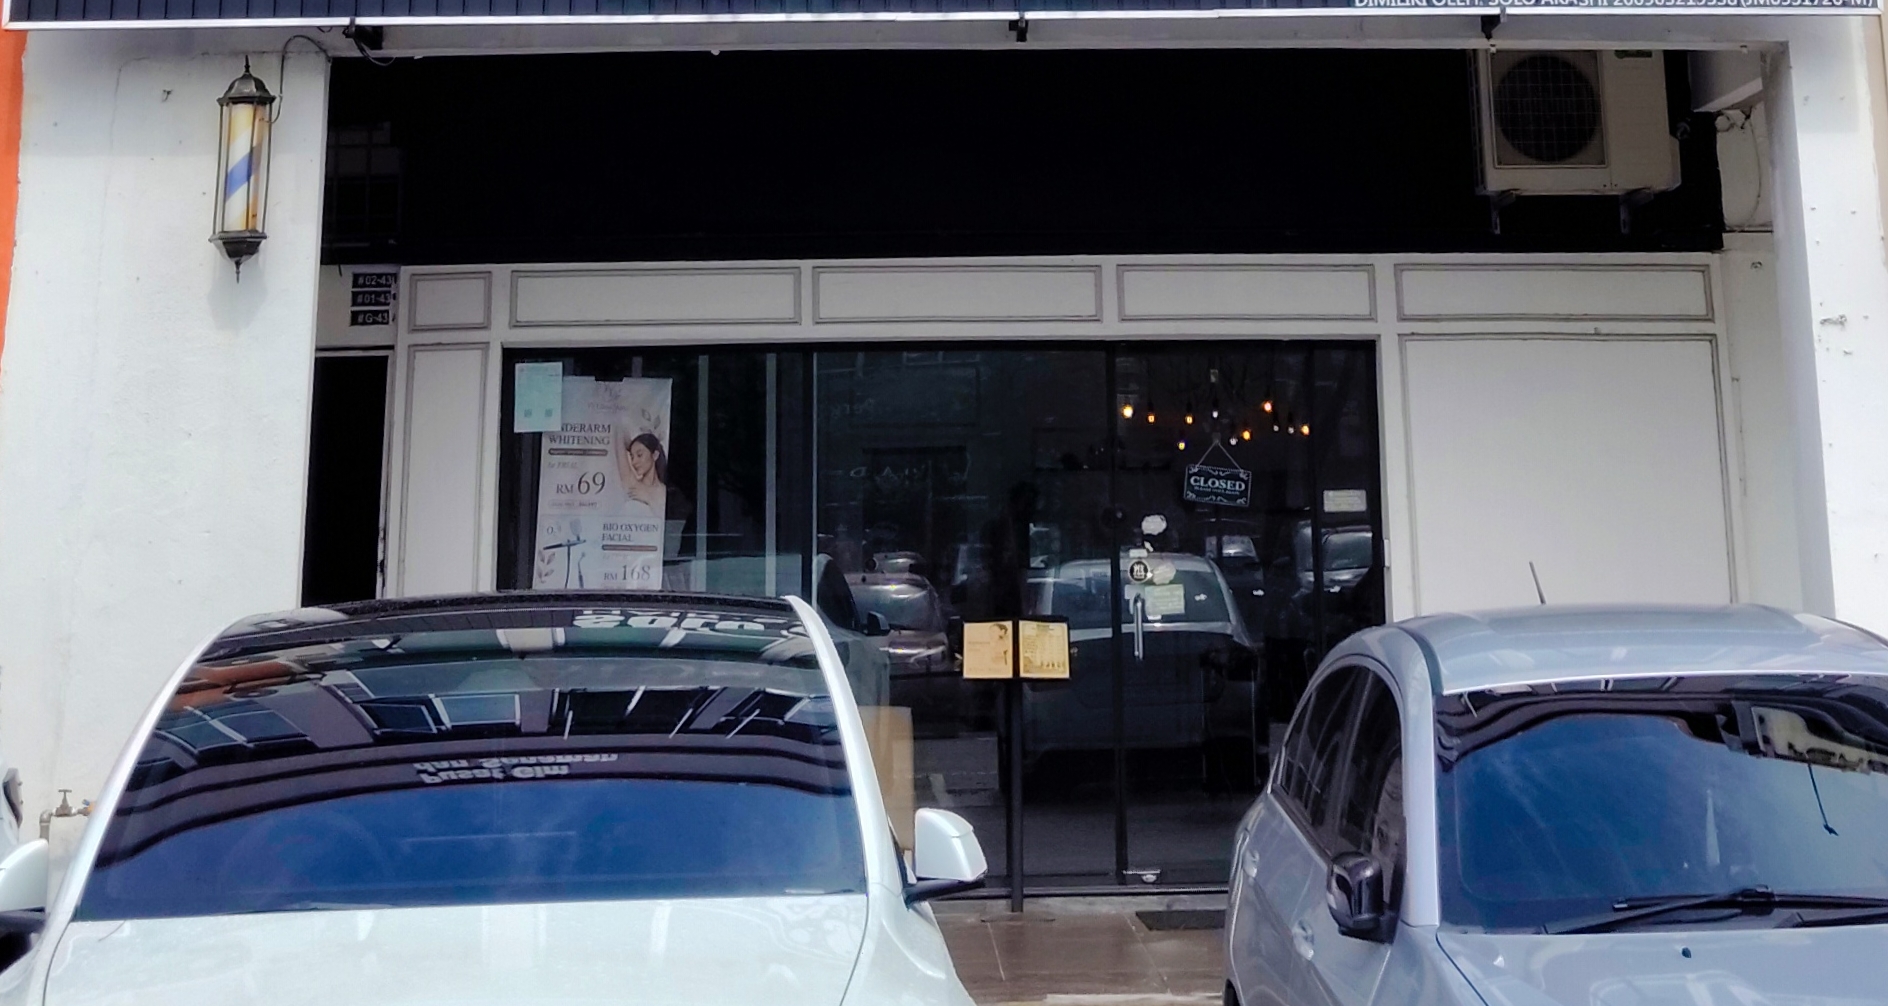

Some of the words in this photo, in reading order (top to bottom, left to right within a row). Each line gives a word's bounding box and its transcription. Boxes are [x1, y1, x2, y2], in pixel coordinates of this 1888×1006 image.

[561, 423, 611, 434] NDERARM
[549, 434, 611, 446] WHITENING
[556, 483, 575, 495] RM
[577, 471, 606, 495] 69
[1190, 475, 1246, 492] CLOSED
[602, 523, 619, 532] BIO
[620, 523, 659, 533] OXYGEN
[601, 533, 633, 542] FACIAL
[621, 564, 651, 582] 168
